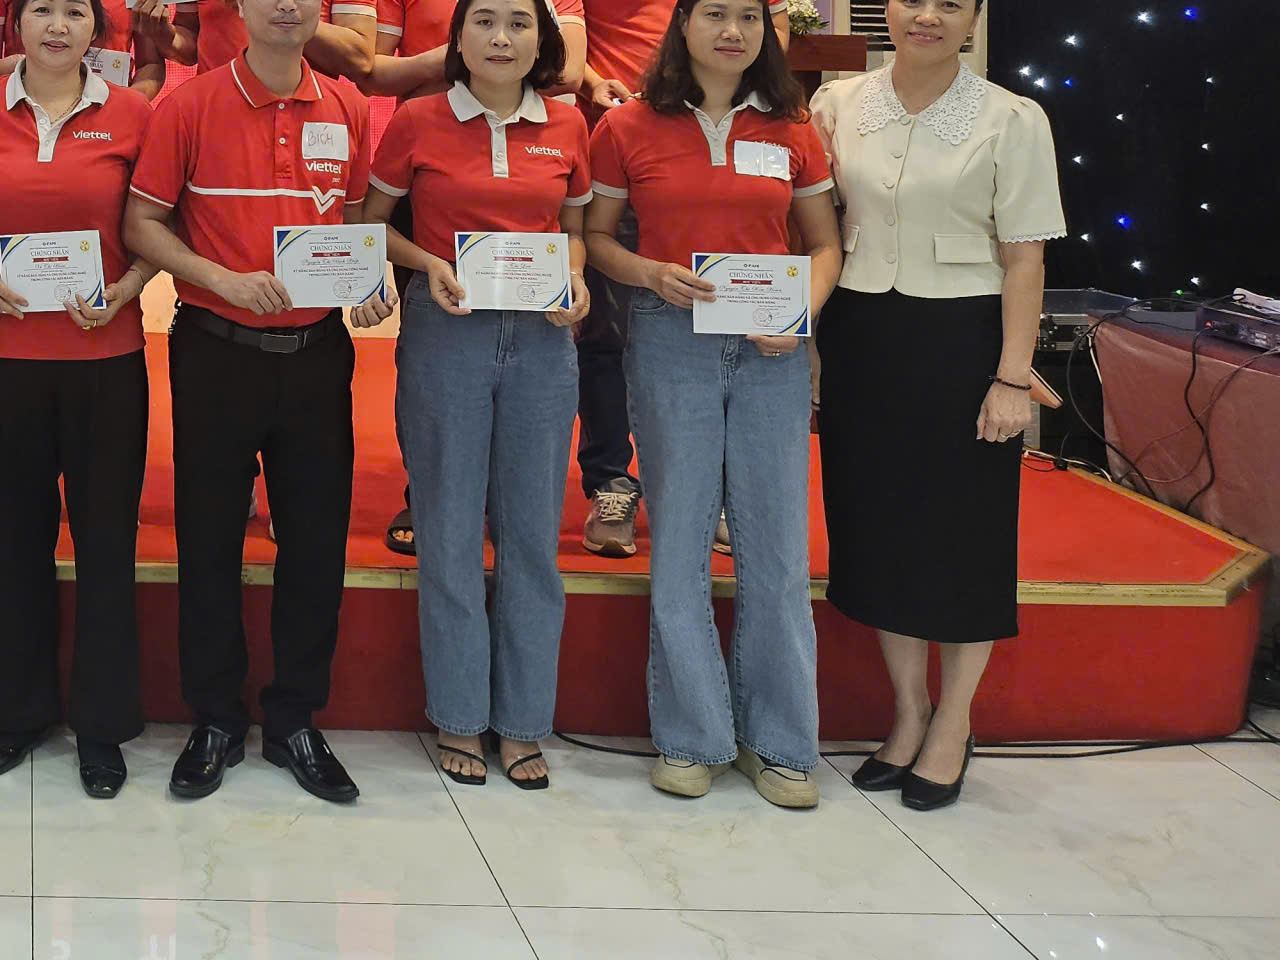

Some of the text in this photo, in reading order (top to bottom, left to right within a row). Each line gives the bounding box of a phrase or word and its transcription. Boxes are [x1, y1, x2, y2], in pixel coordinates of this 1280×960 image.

[72, 130, 113, 141] viettel
[525, 145, 564, 158] viettel
[305, 161, 342, 174] viettel
